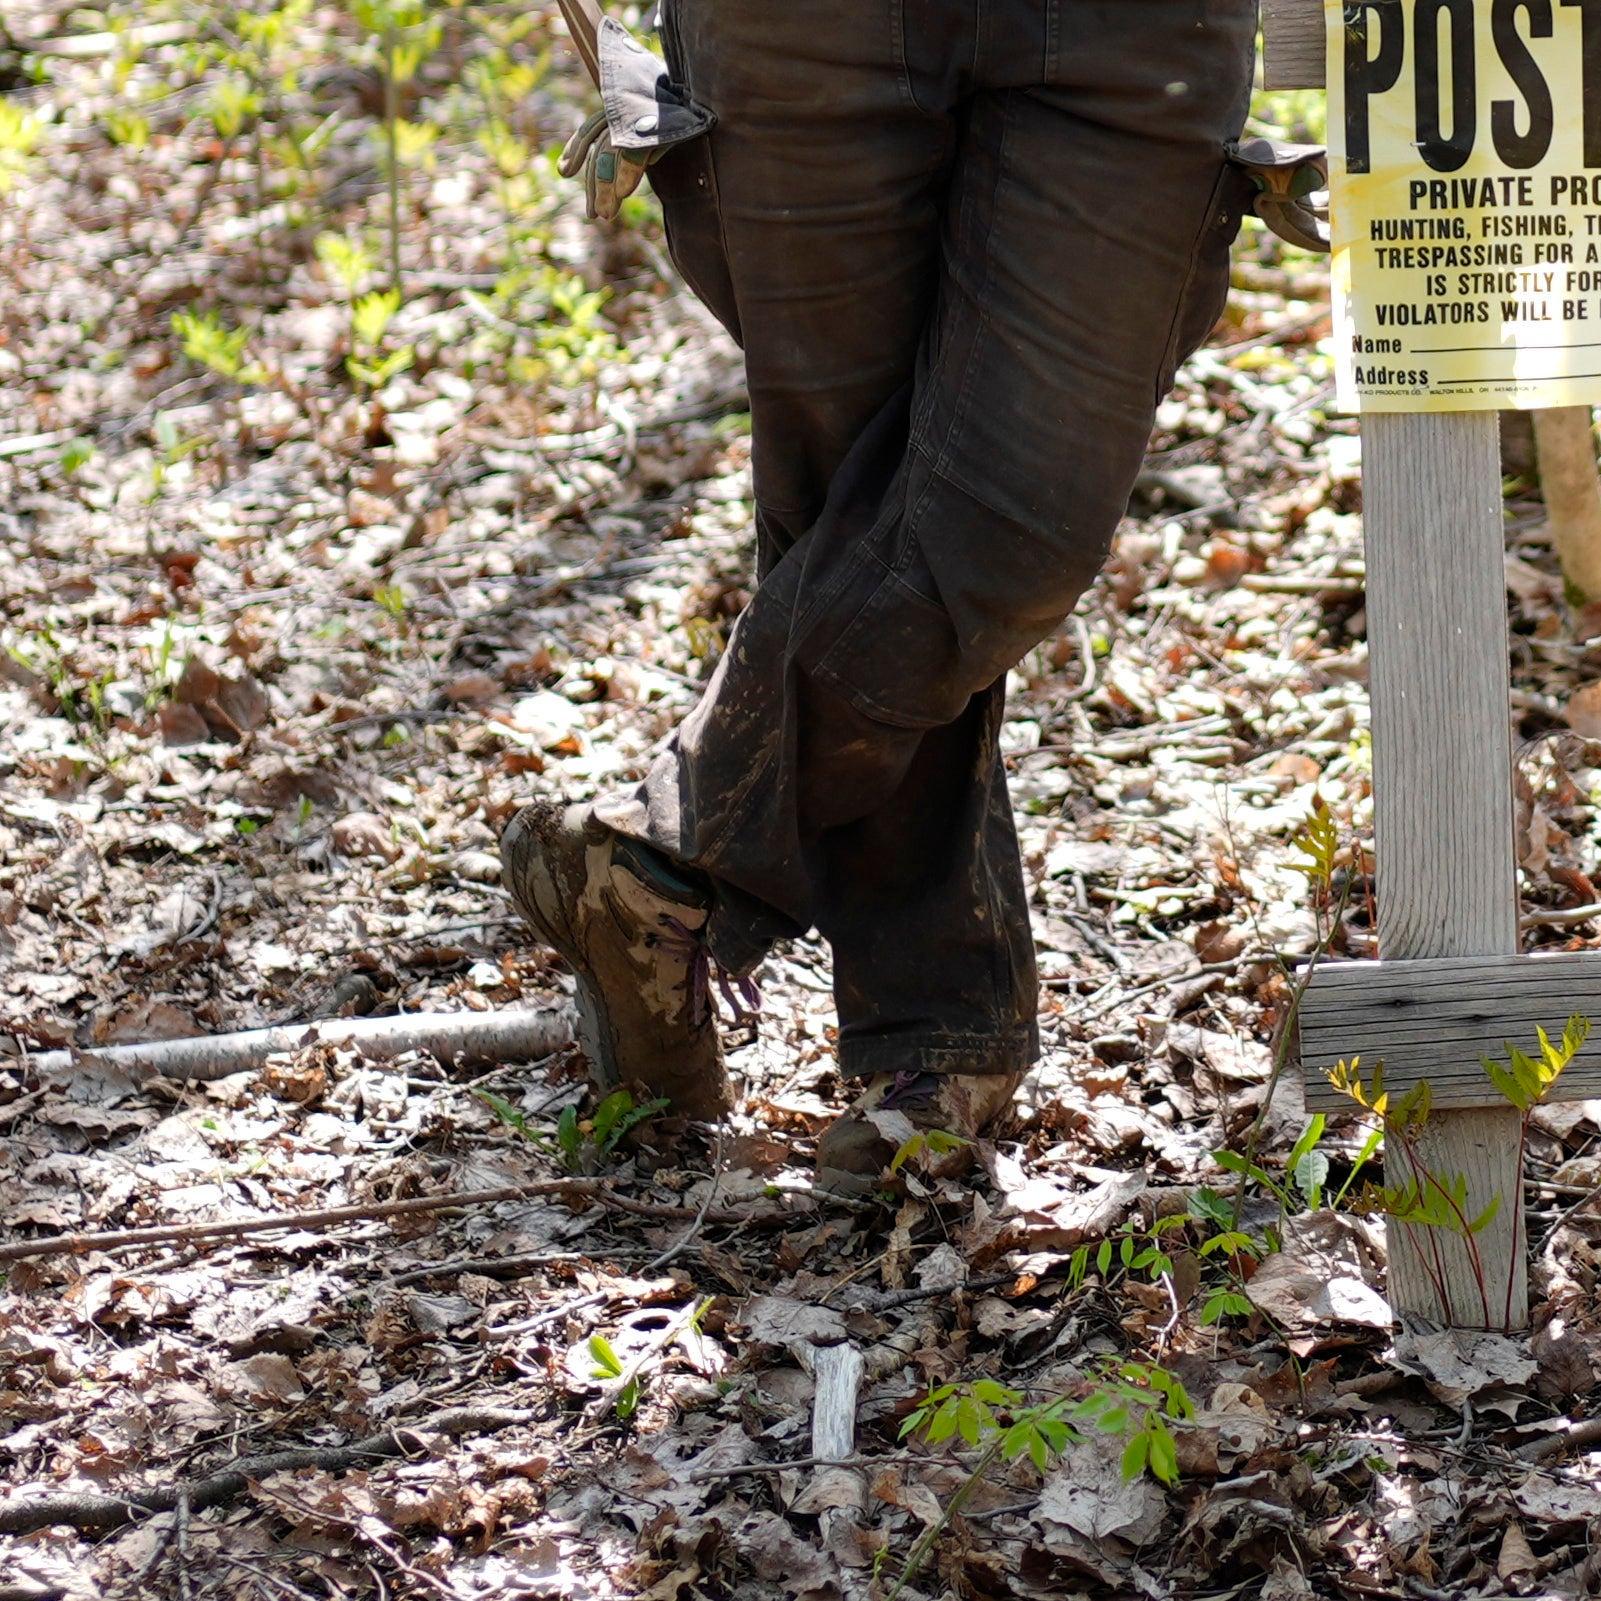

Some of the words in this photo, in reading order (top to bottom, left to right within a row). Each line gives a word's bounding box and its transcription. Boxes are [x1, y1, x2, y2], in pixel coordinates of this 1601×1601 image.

[1410, 175, 1534, 211] PRIVATE
[1370, 218, 1472, 242] HUNTING,
[1482, 215, 1574, 240] FISHING,
[1375, 246, 1522, 268] TRESPASSING
[1534, 243, 1573, 264] FOR
[1426, 274, 1447, 296] IS
[1458, 270, 1554, 295] STRICTLY
[1375, 302, 1489, 325] VIOLATORS
[1501, 299, 1552, 322] WILL
[1563, 297, 1587, 320] BE
[1351, 335, 1402, 354] Name
[1355, 366, 1429, 386] Address
